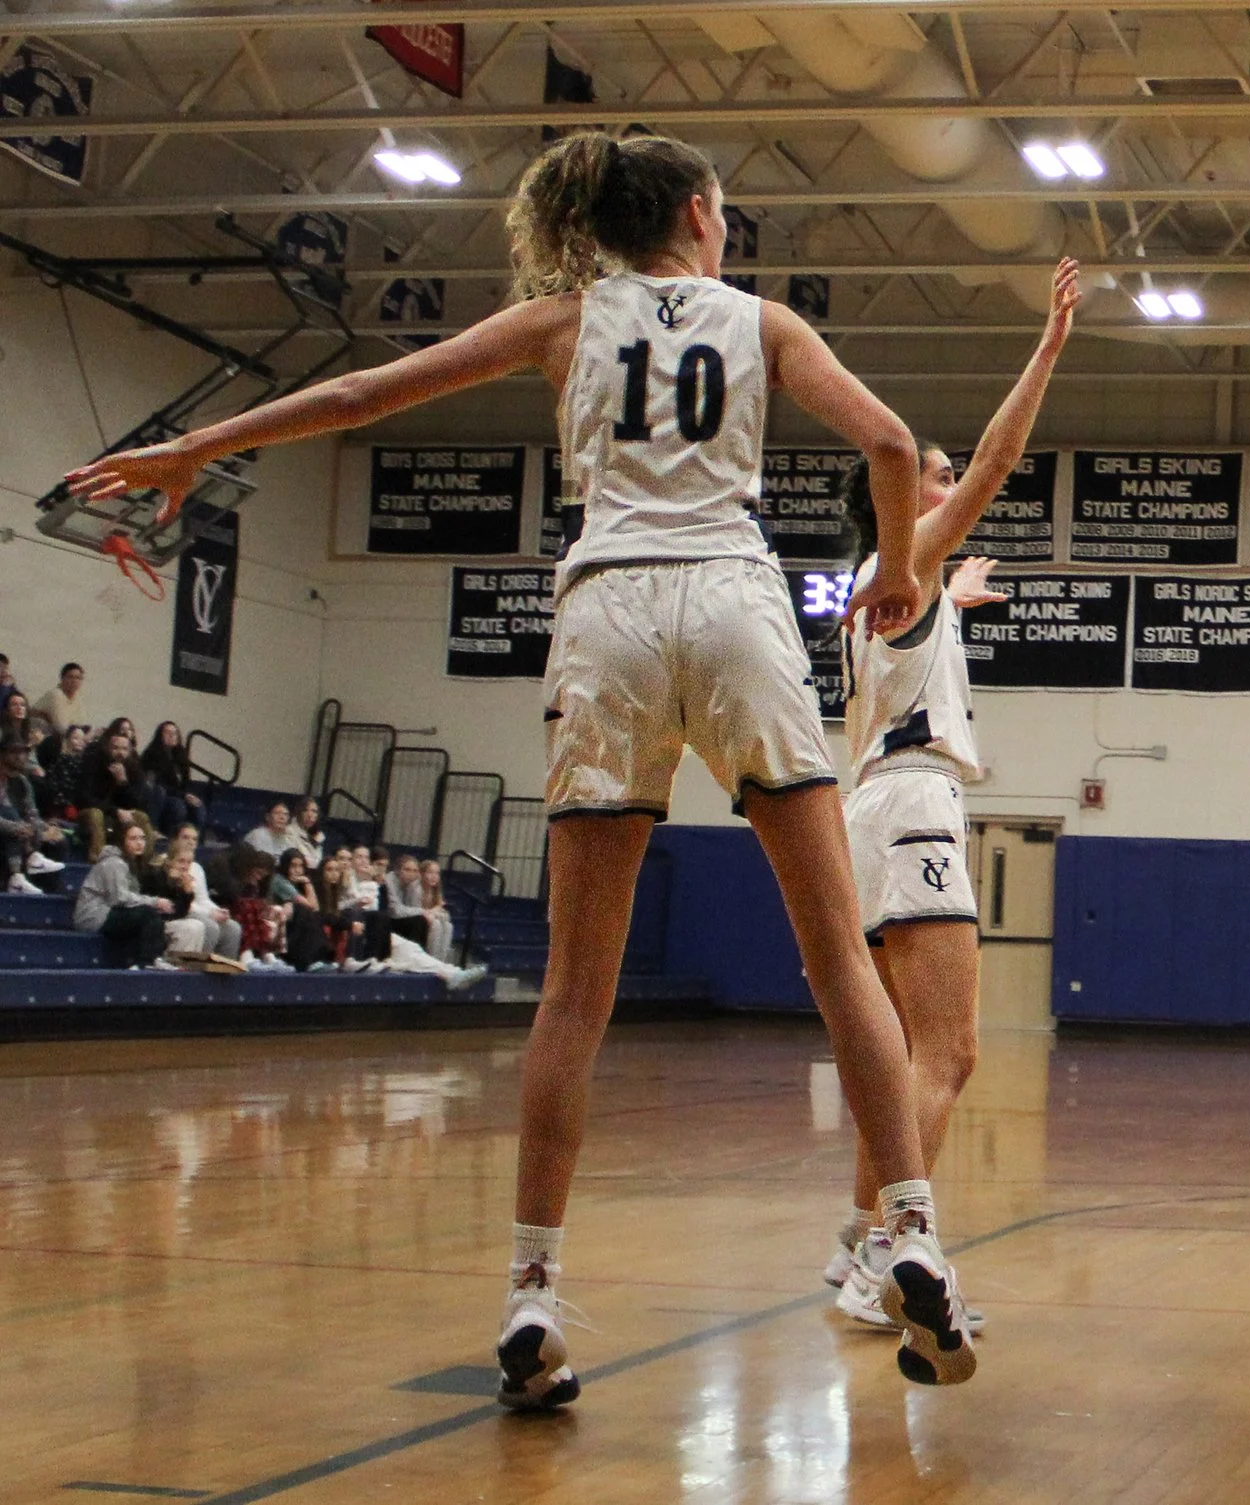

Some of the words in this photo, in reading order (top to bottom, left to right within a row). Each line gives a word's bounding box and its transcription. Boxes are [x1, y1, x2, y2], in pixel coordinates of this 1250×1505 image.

[614, 338, 725, 442] 10
[416, 452, 455, 468] CROSS
[1094, 457, 1151, 475] GIRLS
[1159, 458, 1222, 476] SKIING
[413, 474, 481, 490] MAINE
[762, 476, 831, 493] MAINE
[1121, 479, 1192, 498] MAINE
[378, 494, 425, 511] STATE
[429, 495, 513, 511] CHAMPIONS
[1082, 501, 1132, 519] STATE
[1138, 502, 1229, 520] CHAMPIONS
[1019, 581, 1066, 598] NORDIC
[1070, 582, 1113, 598] SKIING
[1154, 583, 1191, 600] GIRLS
[1195, 584, 1239, 602] NORDIC
[1008, 603, 1081, 620] MAINE
[461, 617, 506, 634] STATE
[970, 624, 1020, 641] STATE
[1026, 625, 1118, 642] CHAMPIONS
[1143, 627, 1193, 644] STATE
